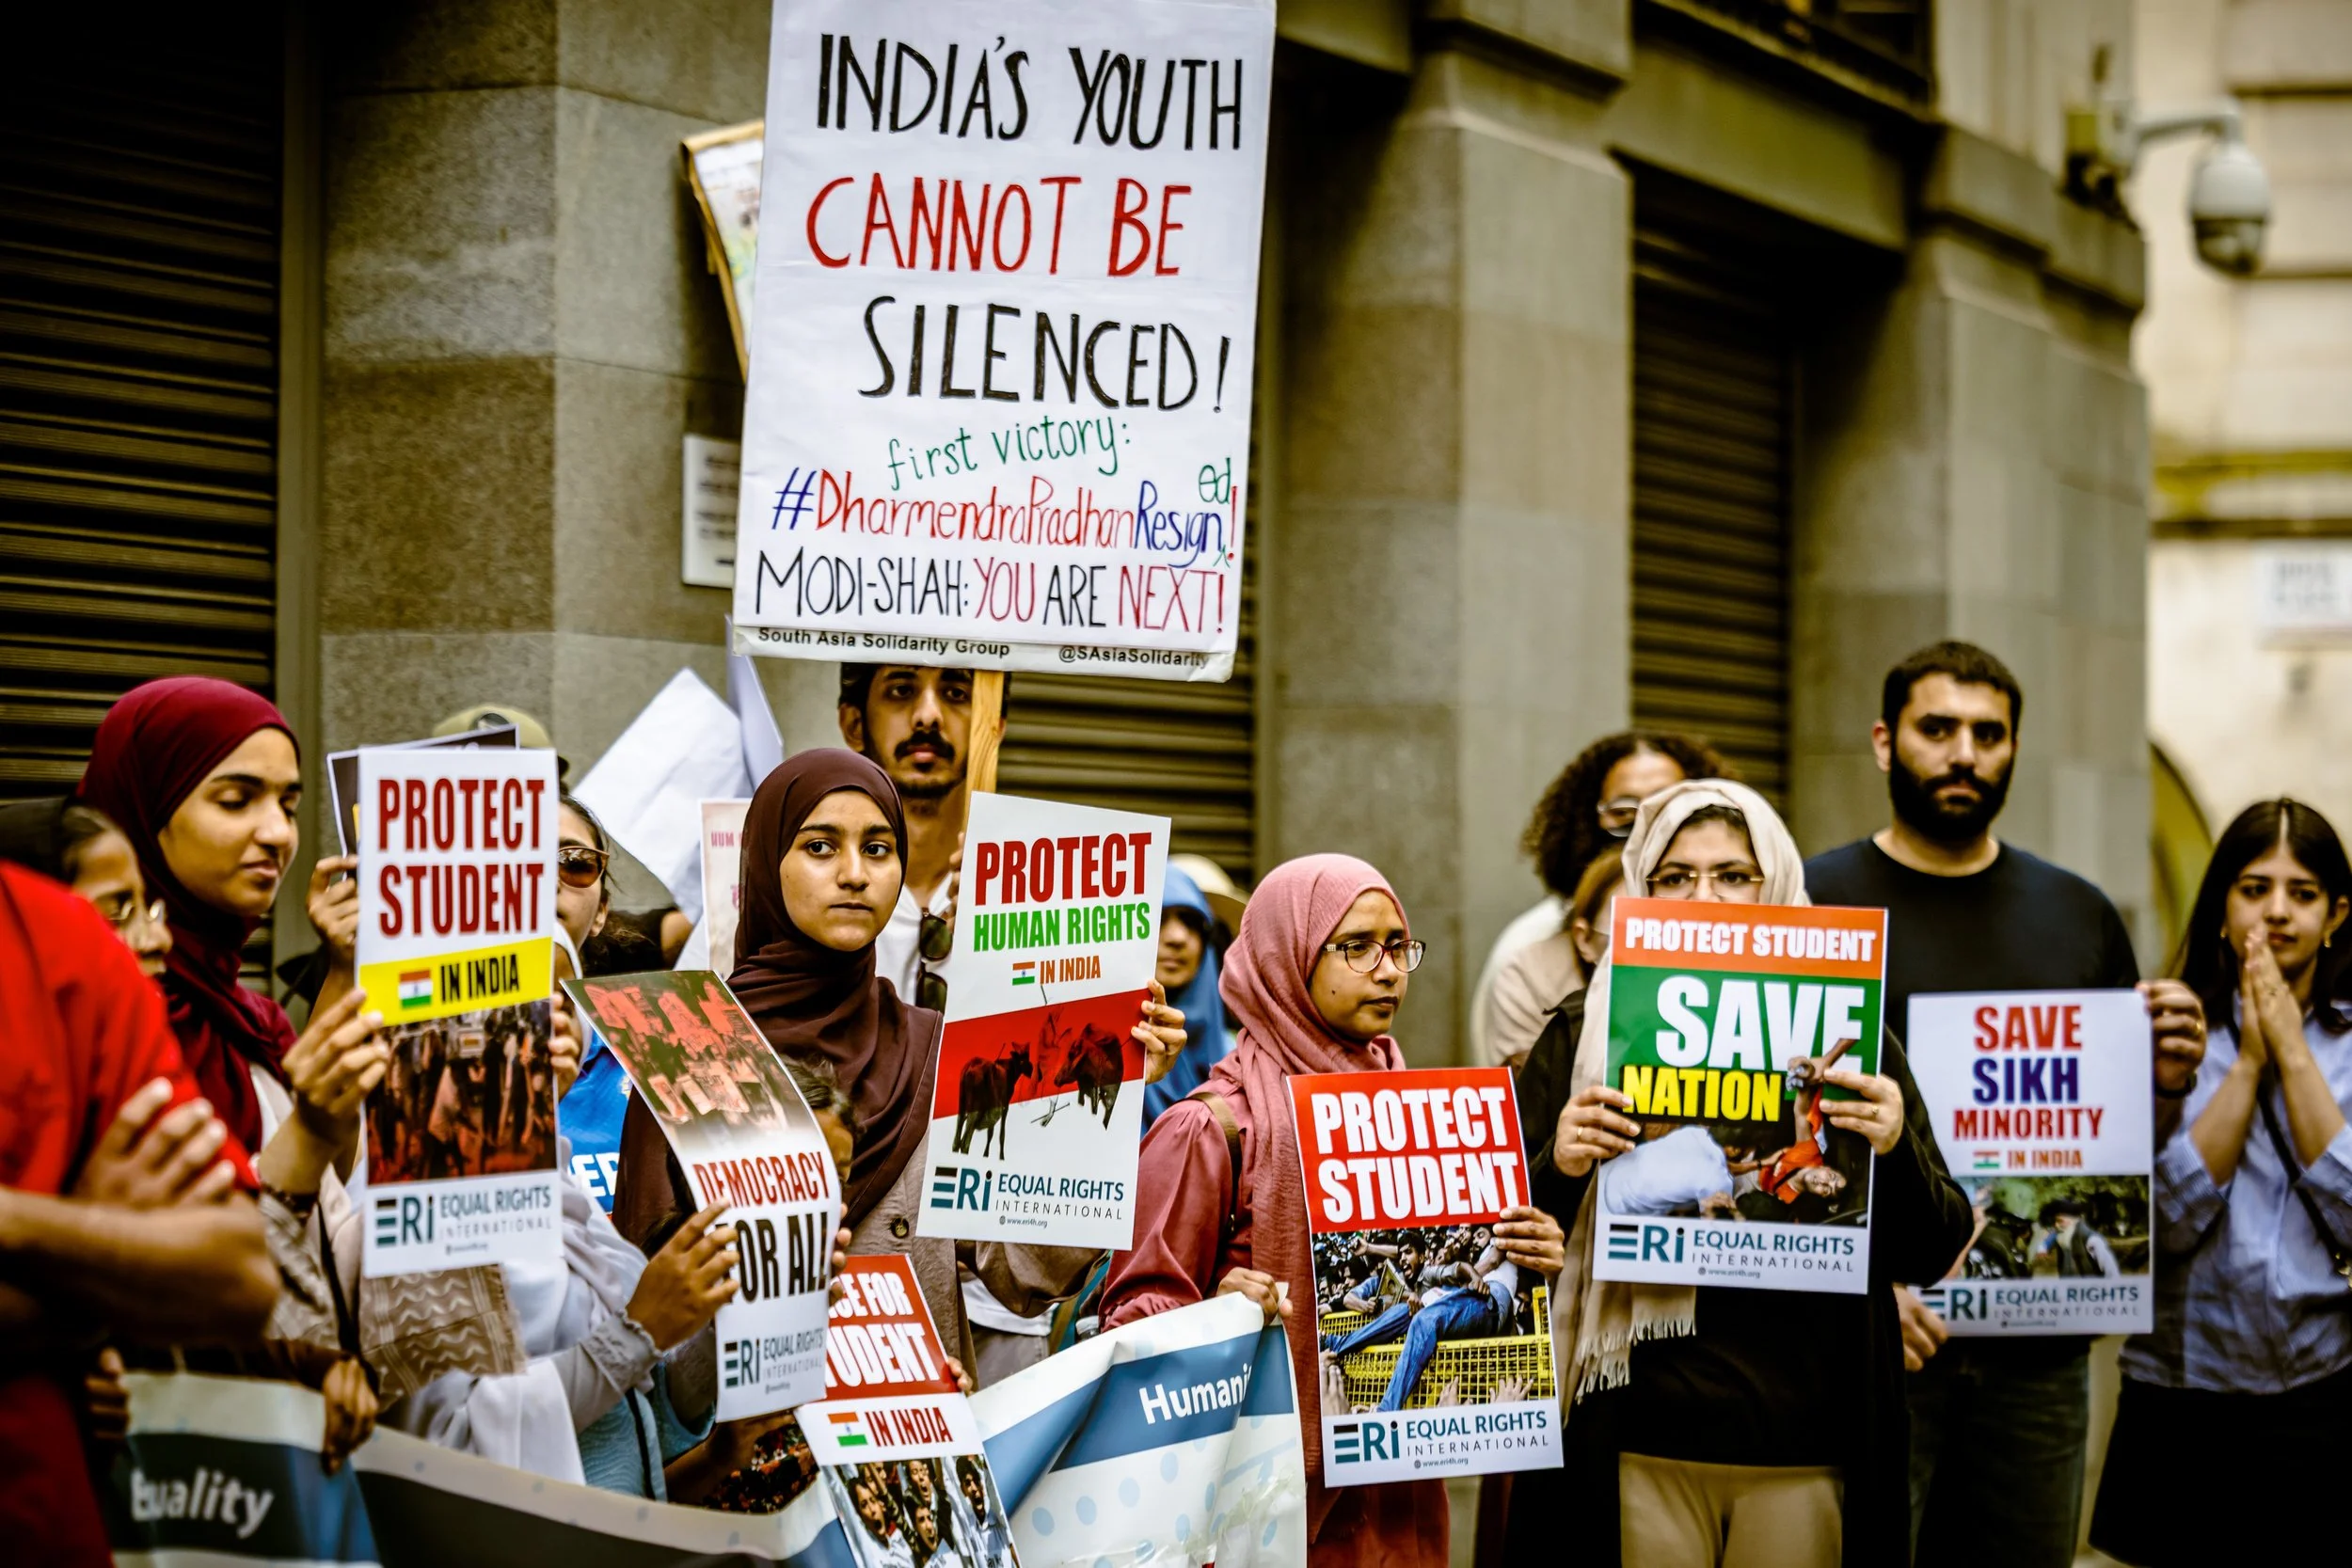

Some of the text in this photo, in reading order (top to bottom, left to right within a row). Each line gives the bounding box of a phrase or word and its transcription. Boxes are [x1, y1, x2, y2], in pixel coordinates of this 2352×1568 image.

[817, 34, 1243, 150] INDIA'S YOUTH
[806, 173, 1192, 277] CANNOT BE
[888, 417, 1131, 490] first victory:
[755, 549, 1225, 635] MODI-SHAH: YOU ARE NEXT!
[758, 627, 1210, 669] South Asia Solidarity Group @SAsiaSolidarity
[378, 778, 545, 851] PROTECT
[975, 832, 1152, 906] PROTECT
[379, 863, 544, 937] STUDENT
[973, 903, 1151, 952] HUMAN RIGHTS
[1626, 917, 1876, 962] PROTECT STUDENT
[440, 954, 519, 1004] IN INDIA
[1040, 956, 1101, 985] IN INDIA
[1656, 974, 1865, 1073] SAVE
[1973, 1005, 2082, 1053] SAVE
[1622, 1065, 1781, 1122] NATION
[1973, 1057, 2079, 1105] SIKH
[1311, 1087, 1507, 1155] PROTECT
[1953, 1108, 2104, 1141] MINORITY
[692, 1151, 829, 1208] DEMOCRACY
[2008, 1149, 2083, 1168] IN INDIA
[440, 1194, 491, 1220] EQUAL
[495, 1186, 551, 1213] RIGHTS
[995, 1199, 1121, 1220] INTERNATIONAL
[998, 1174, 1054, 1196] EQUAL
[1059, 1179, 1124, 1201] RIGHTS
[1318, 1152, 1520, 1223] STUDENT
[440, 1218, 551, 1240] INTERNATIONAL
[1693, 1230, 1767, 1252] EQUAL
[1773, 1235, 1854, 1256] RIGHTS
[787, 1212, 828, 1296] ALL
[1692, 1253, 1853, 1273] INTERNATIONAL
[857, 1273, 914, 1316] FOR
[1994, 1306, 2138, 1319] INTERNATIONAL
[1995, 1290, 2060, 1307] EQUAL
[2067, 1287, 2138, 1303] RIGHTS
[764, 1336, 794, 1362] EQUAL
[865, 1407, 953, 1448] IN INDIA
[1406, 1418, 1470, 1440] EQUAL
[1475, 1411, 1547, 1433] RIGHTS
[1407, 1435, 1549, 1457] INTERNATIONAL
